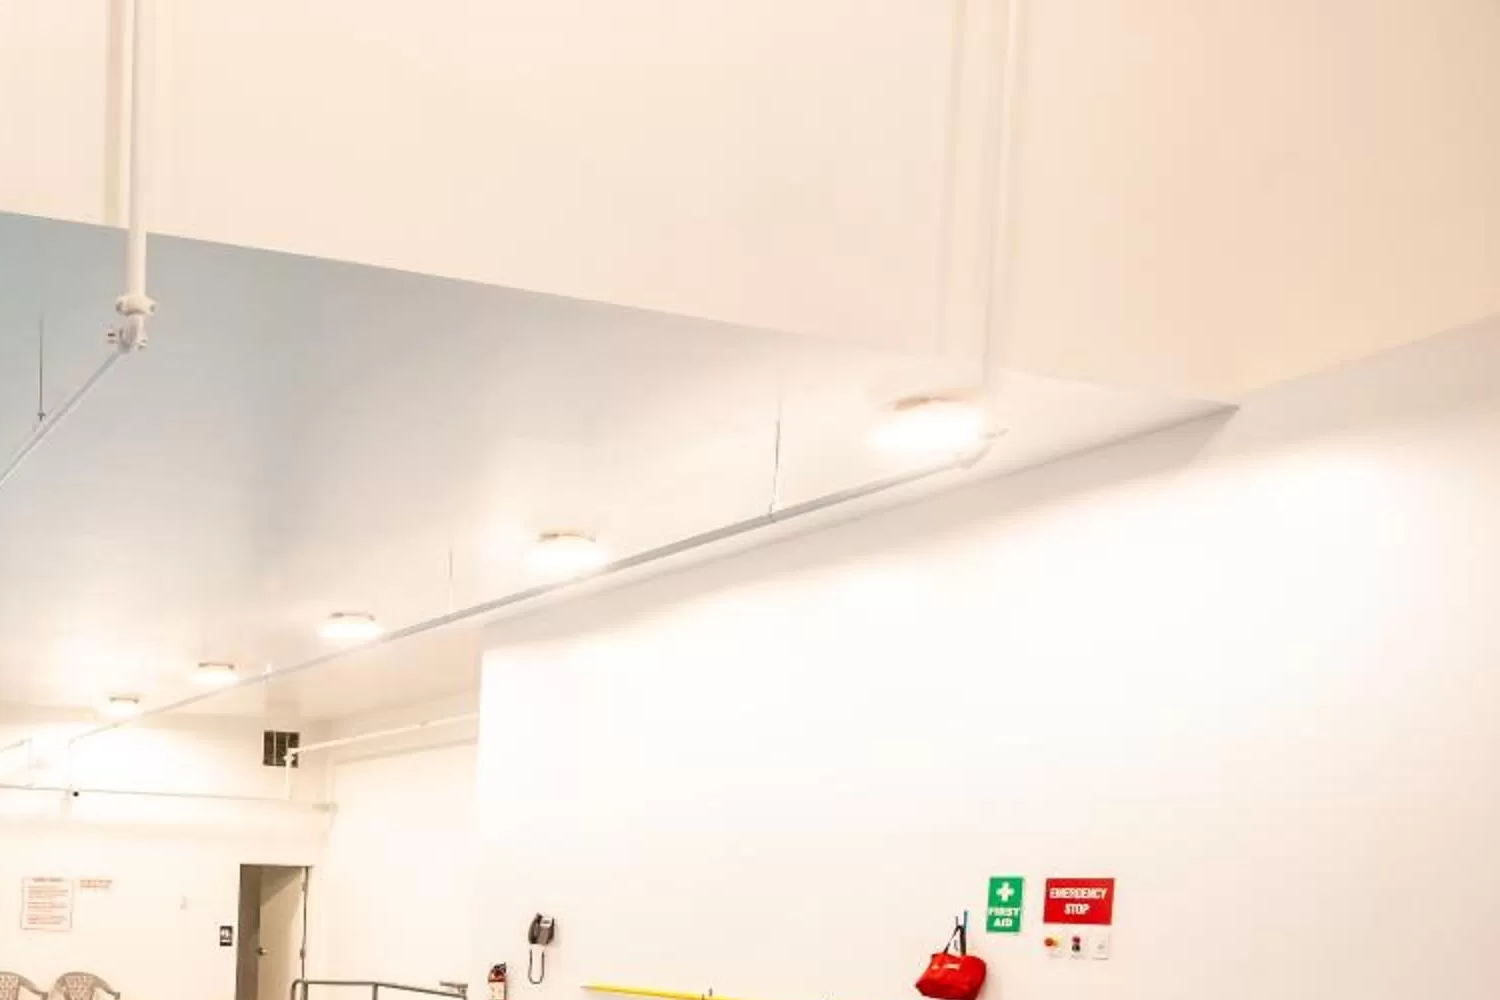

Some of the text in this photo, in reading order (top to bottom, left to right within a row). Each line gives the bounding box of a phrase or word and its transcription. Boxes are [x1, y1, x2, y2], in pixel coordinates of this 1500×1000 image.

[1049, 887, 1107, 899] EMERGENCY
[989, 907, 1020, 916] FIRST
[1064, 903, 1090, 915] STOP
[993, 918, 1013, 927] AID
